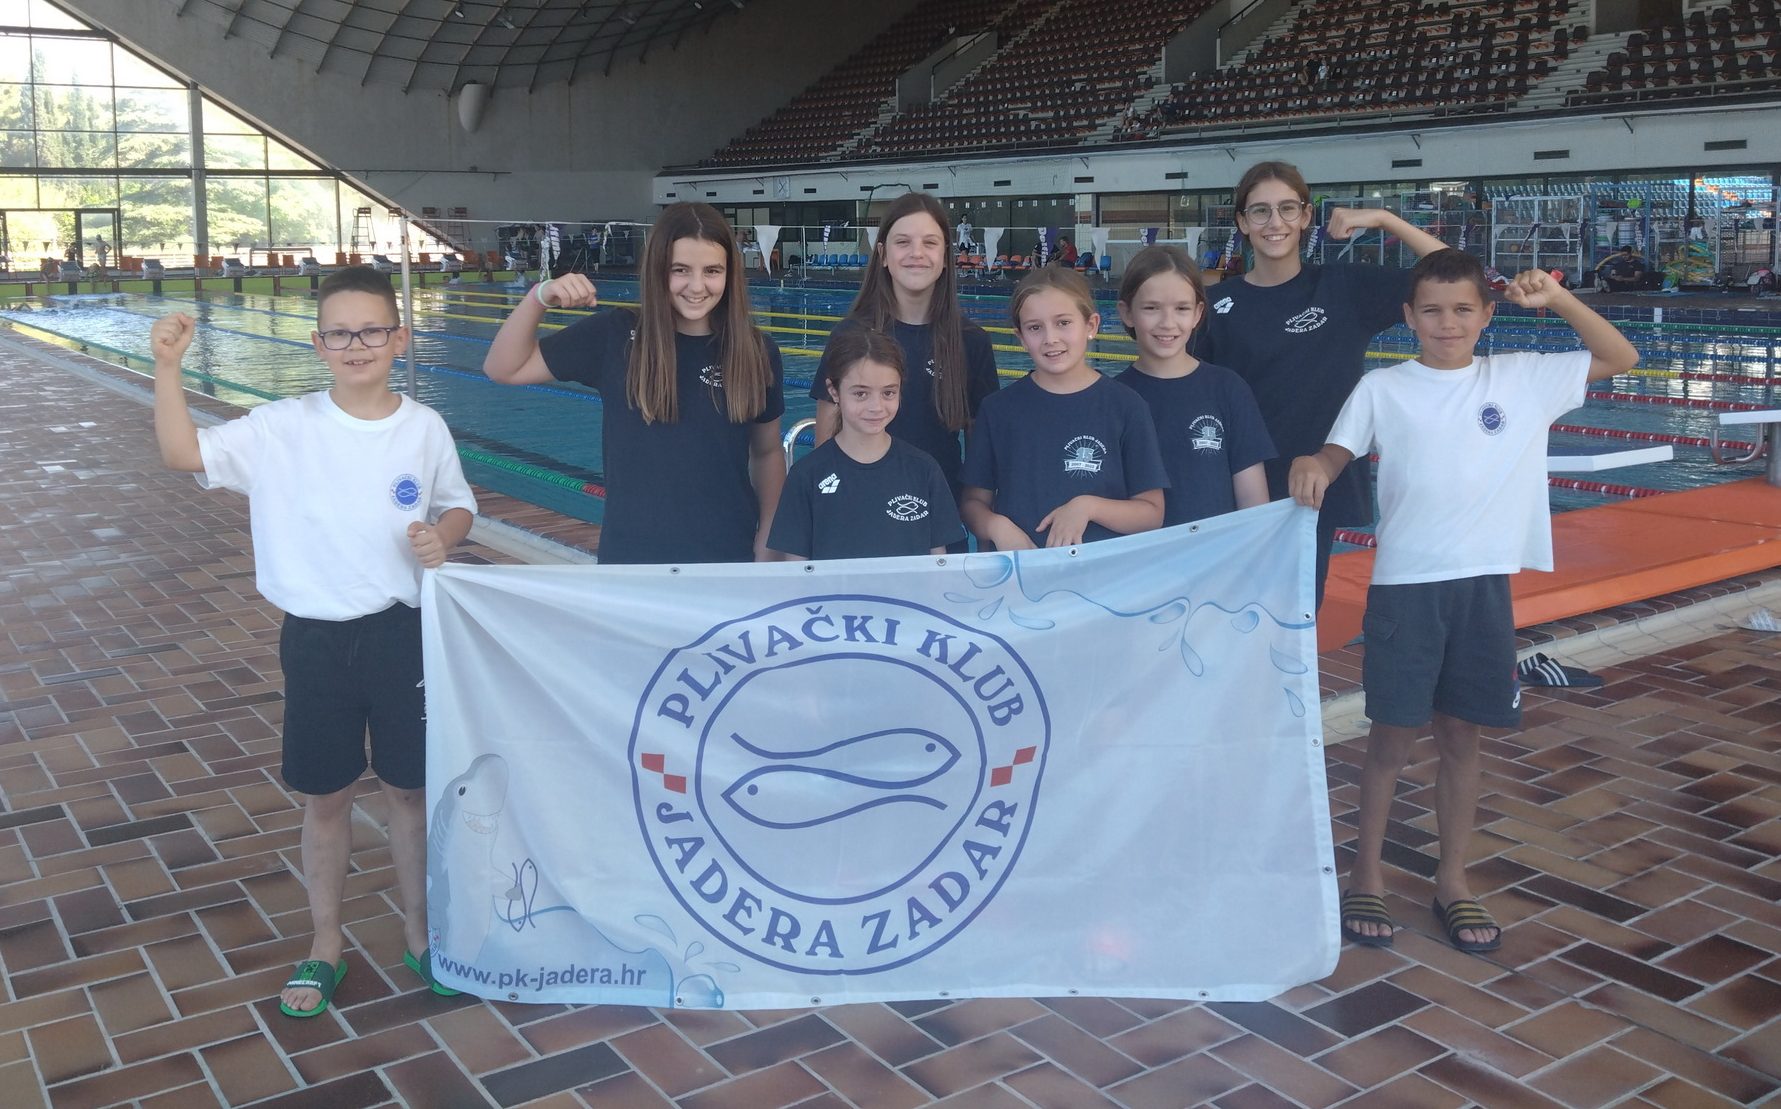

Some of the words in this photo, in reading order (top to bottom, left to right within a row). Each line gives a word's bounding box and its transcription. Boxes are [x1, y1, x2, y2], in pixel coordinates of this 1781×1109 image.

[818, 472, 838, 490] arena
[886, 509, 910, 522] JADERA
[657, 605, 900, 728] PLIVAČKI
[916, 629, 1024, 726] KLUB
[656, 801, 844, 958] JADERA
[861, 800, 1018, 955] ZADAR
[438, 953, 647, 992] www.pk-jadera.hr
